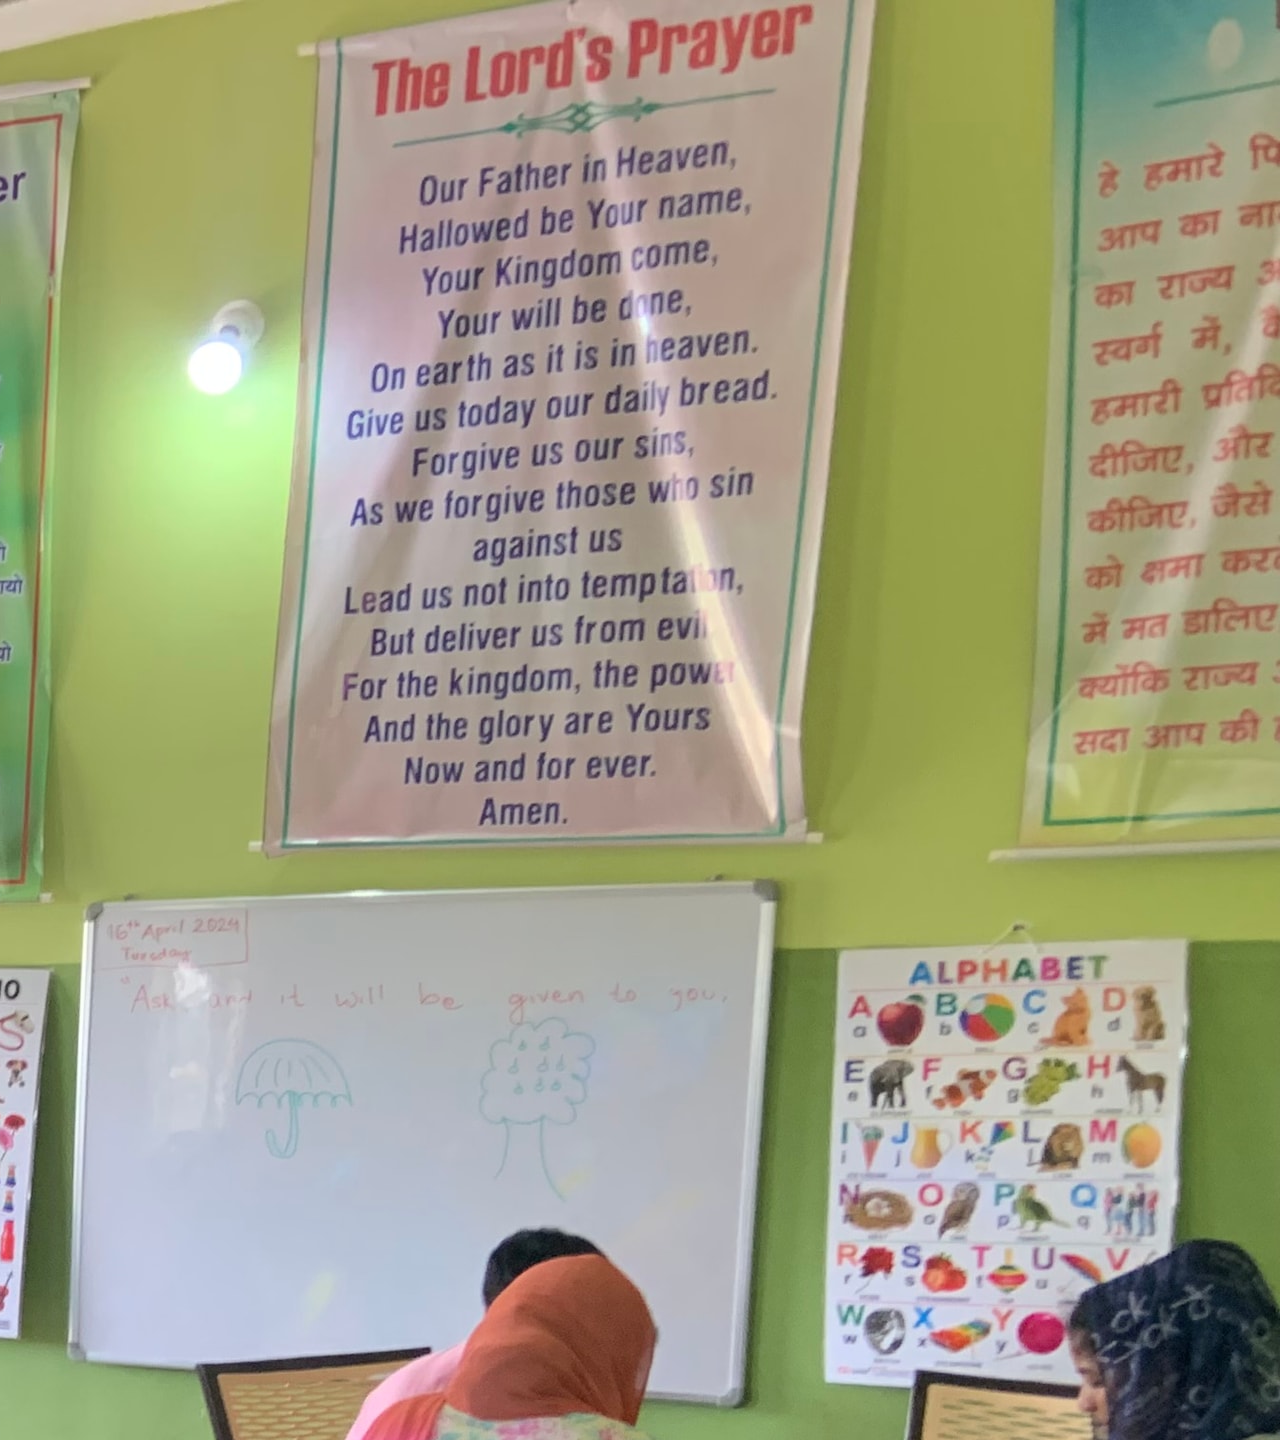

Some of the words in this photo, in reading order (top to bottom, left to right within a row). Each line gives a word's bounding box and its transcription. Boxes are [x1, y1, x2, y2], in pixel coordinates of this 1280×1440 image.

[373, 58, 450, 116] The
[464, 27, 612, 103] Lord's
[627, 4, 812, 79] Prayer
[419, 172, 467, 207] Our
[478, 158, 572, 198] Father
[584, 154, 607, 182] in
[616, 139, 736, 177] Heaven,
[1098, 160, 1120, 198] हे
[1144, 142, 1225, 191] हमारे
[399, 209, 528, 254] Hallowed
[540, 203, 573, 236] be
[587, 198, 645, 230] Your
[658, 187, 751, 219] name,
[1098, 219, 1162, 252] आप
[1179, 210, 1221, 238] का
[421, 265, 483, 296] Your
[495, 249, 621, 290] Kingdom
[631, 237, 718, 272] come,
[1095, 280, 1136, 309] का
[1157, 265, 1235, 299] राज्य
[438, 309, 499, 339] Your
[511, 298, 559, 331] will
[572, 293, 606, 325] be
[619, 288, 692, 320] done,
[371, 362, 405, 393] On
[415, 353, 492, 386] earth
[503, 353, 535, 377] as
[546, 344, 564, 373] it
[574, 341, 598, 371] is
[611, 337, 635, 367] in
[646, 329, 758, 364] heaven.
[1093, 321, 1163, 366] स्वर्ग
[346, 408, 404, 441] Give
[415, 405, 447, 432] us
[457, 398, 536, 434] today
[546, 394, 594, 421] our
[604, 384, 669, 416] daily
[679, 369, 777, 407] bread.
[1090, 378, 1182, 425] हमारी
[1202, 362, 1280, 410] प्रतिदि
[412, 442, 520, 480] Forgive
[531, 440, 563, 466] us
[574, 436, 624, 464] our
[634, 427, 694, 459] sins,
[1089, 439, 1194, 478] दीजिए,
[1213, 424, 1274, 462] और
[350, 497, 383, 527] As
[395, 495, 434, 523] we
[443, 485, 545, 521] forgive
[555, 480, 635, 510] those
[648, 474, 699, 504] who
[710, 466, 754, 498] sin
[1087, 495, 1196, 533] कीजिए,
[1211, 480, 1273, 517] जैसे
[473, 527, 578, 566] against
[589, 527, 623, 554] us
[1084, 555, 1124, 590] को
[1140, 553, 1205, 585] क्षमा
[344, 583, 411, 615] Lead
[422, 583, 453, 611] us
[463, 576, 508, 607] not
[517, 573, 571, 603] into
[370, 627, 415, 658] But
[424, 621, 522, 654] deliver
[531, 623, 564, 649] us
[574, 614, 646, 645] from
[1122, 613, 1170, 640] मत
[342, 671, 388, 703] For
[396, 667, 439, 698] the
[449, 663, 582, 701] kingdom,
[593, 658, 640, 689] the
[1182, 662, 1260, 691] राज्य
[363, 713, 416, 744] And
[425, 710, 469, 740] the
[478, 707, 555, 748] glory
[564, 708, 614, 736] are
[626, 702, 712, 733] Yours
[1074, 727, 1131, 755] सदा
[1144, 722, 1207, 749] आप
[1219, 708, 1261, 743] की
[404, 757, 465, 786] Now
[474, 752, 526, 784] and
[536, 751, 577, 781] for
[585, 751, 657, 780] ever.
[478, 797, 569, 827] Amen.
[141, 919, 184, 943] April
[192, 917, 239, 934] 2024
[121, 947, 192, 962] Tuesday
[909, 955, 1108, 986] ALPHABET
[280, 984, 304, 1008] it
[336, 984, 383, 1008] will
[418, 982, 464, 1011] be
[508, 988, 585, 1026] given
[609, 982, 638, 1004] to
[848, 995, 872, 1018] A
[935, 993, 957, 1016] B
[1022, 990, 1046, 1014] C
[1102, 987, 1126, 1012] D
[844, 1060, 864, 1083] E
[922, 1058, 942, 1081] F
[1002, 1056, 1028, 1081] G
[1086, 1054, 1111, 1079] H
